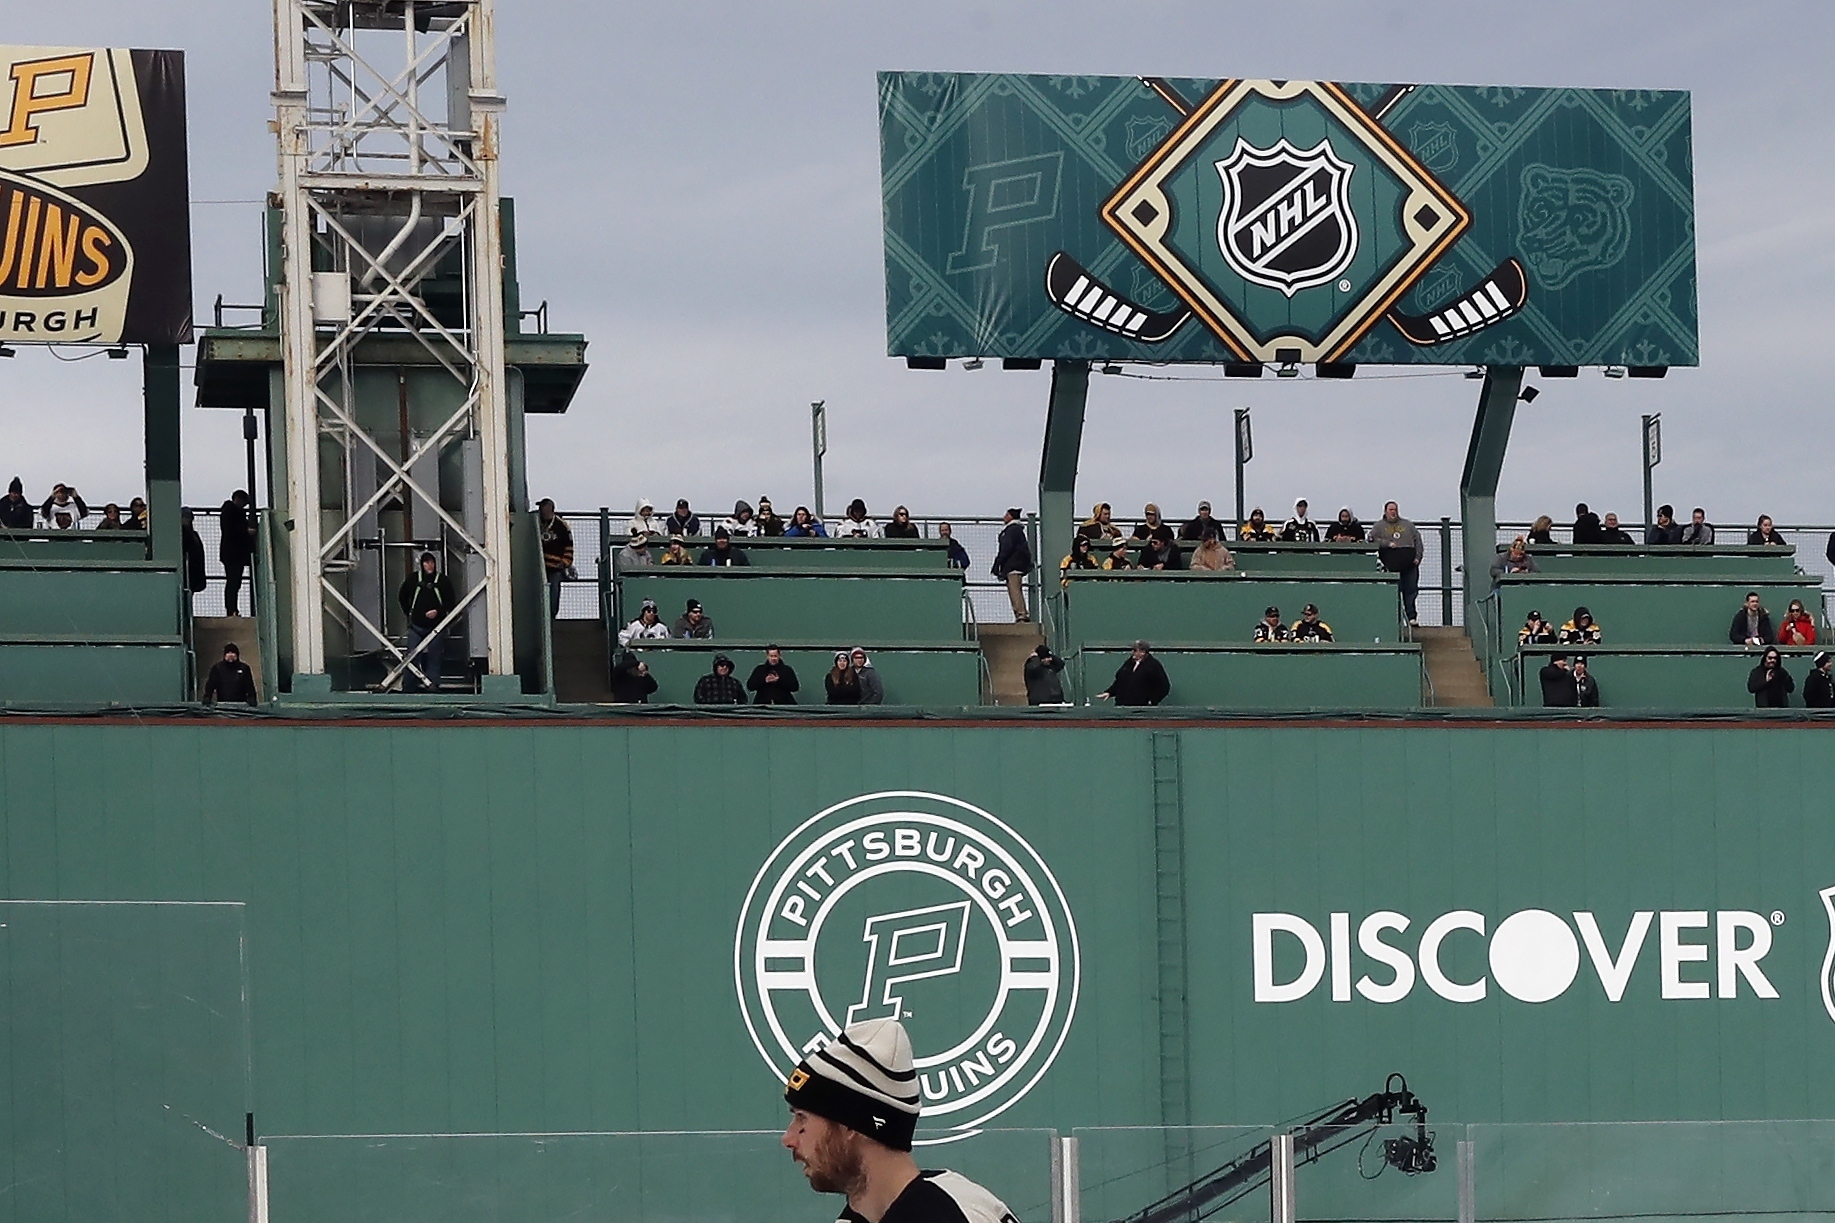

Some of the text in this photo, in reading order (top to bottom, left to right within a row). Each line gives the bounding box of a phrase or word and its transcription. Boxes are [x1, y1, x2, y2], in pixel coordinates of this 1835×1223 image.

[1251, 179, 1327, 258] NHL
[780, 828, 1033, 928] PITTSBURGH
[1252, 909, 1780, 1003] DISCOVER
[802, 1031, 1018, 1101] UINS
